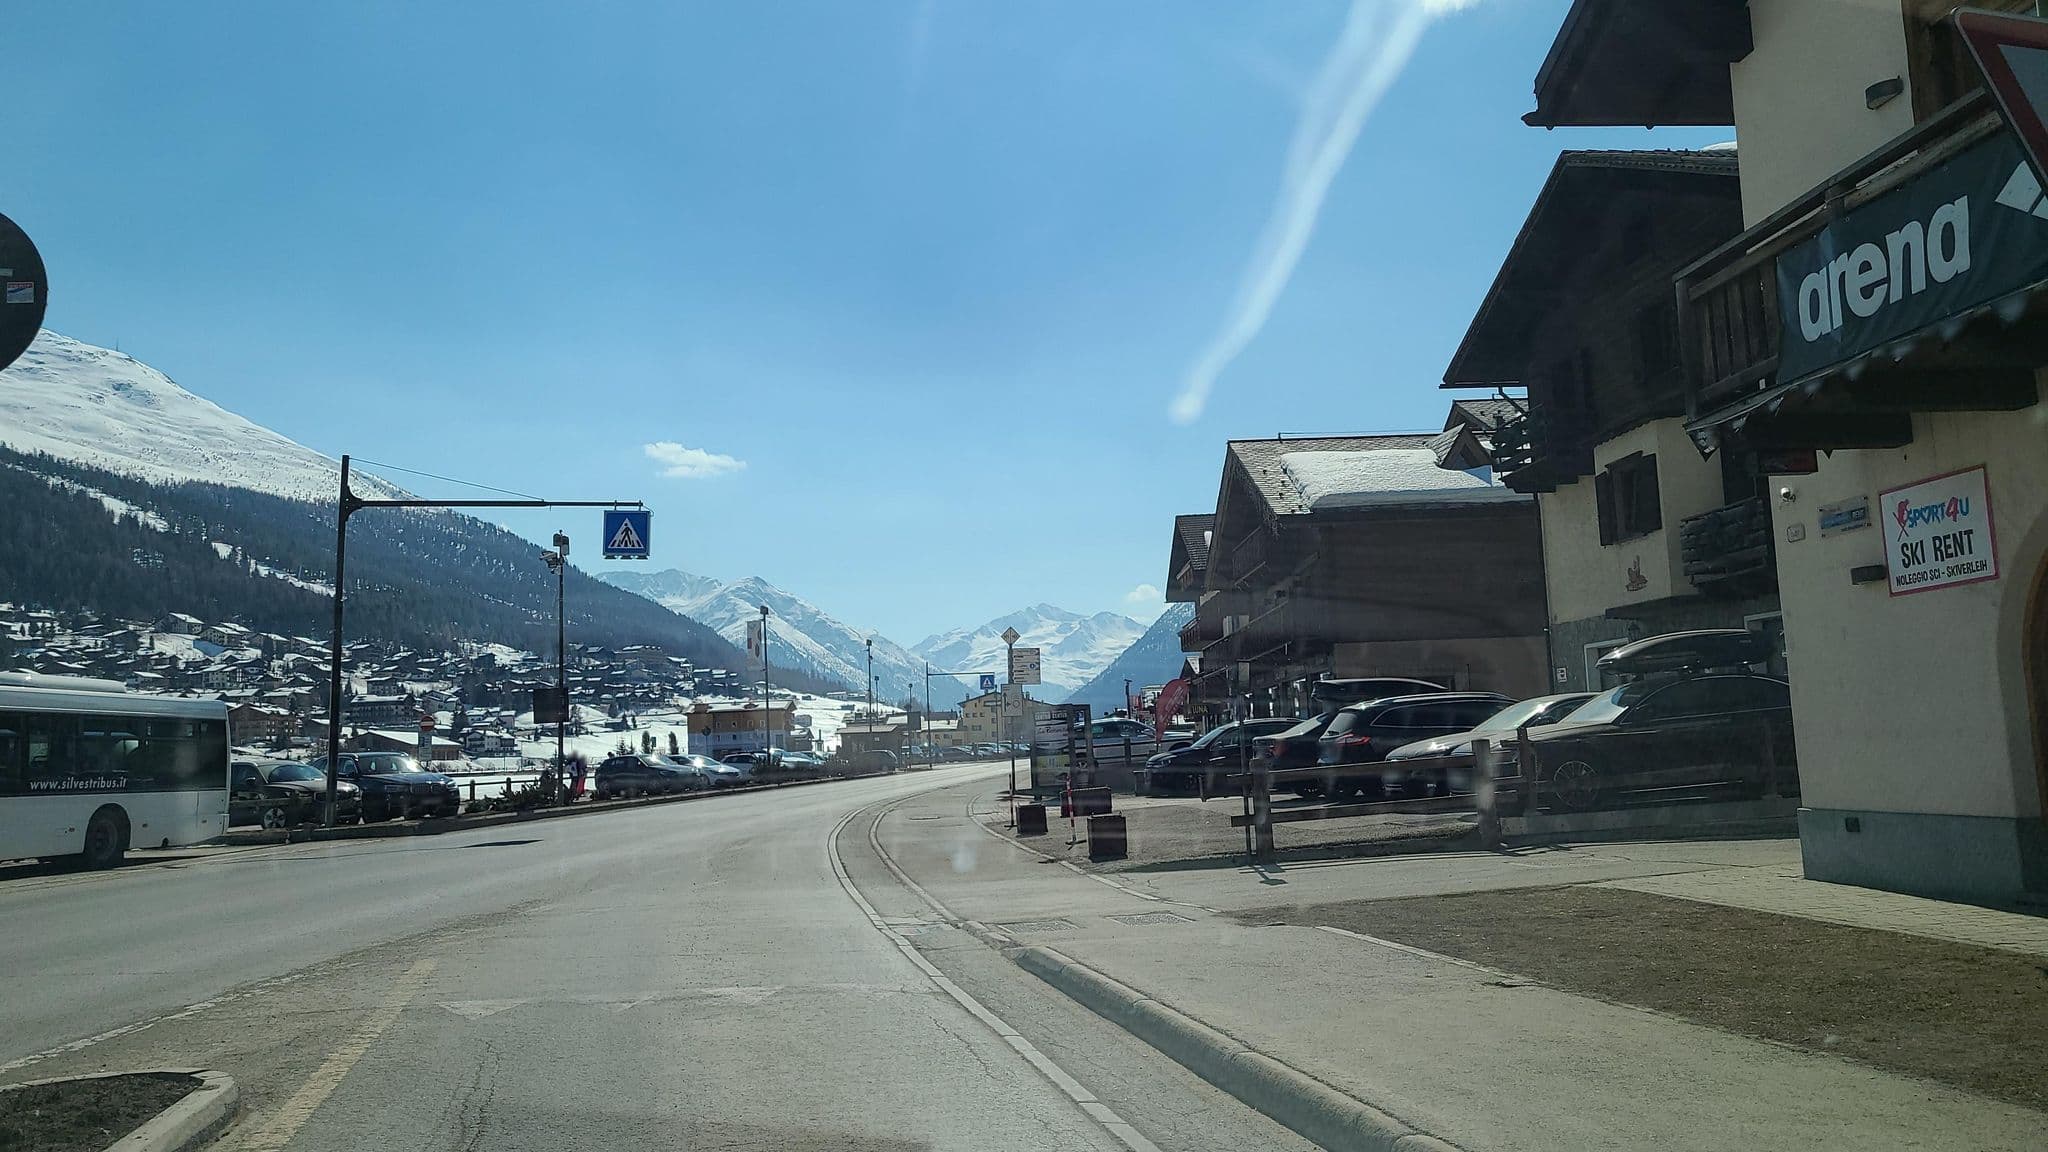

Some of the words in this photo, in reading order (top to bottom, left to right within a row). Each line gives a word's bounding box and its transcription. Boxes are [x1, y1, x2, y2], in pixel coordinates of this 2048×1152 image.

[1798, 195, 1971, 342] arena
[1901, 540, 1926, 569] SKI
[1932, 529, 1974, 562] RENT
[1896, 571, 1928, 587] NOLEGGIO
[1929, 568, 1941, 580] SCI
[1946, 560, 1988, 578] SKIVERLEIH
[29, 776, 127, 790] www.silvestribus.it
